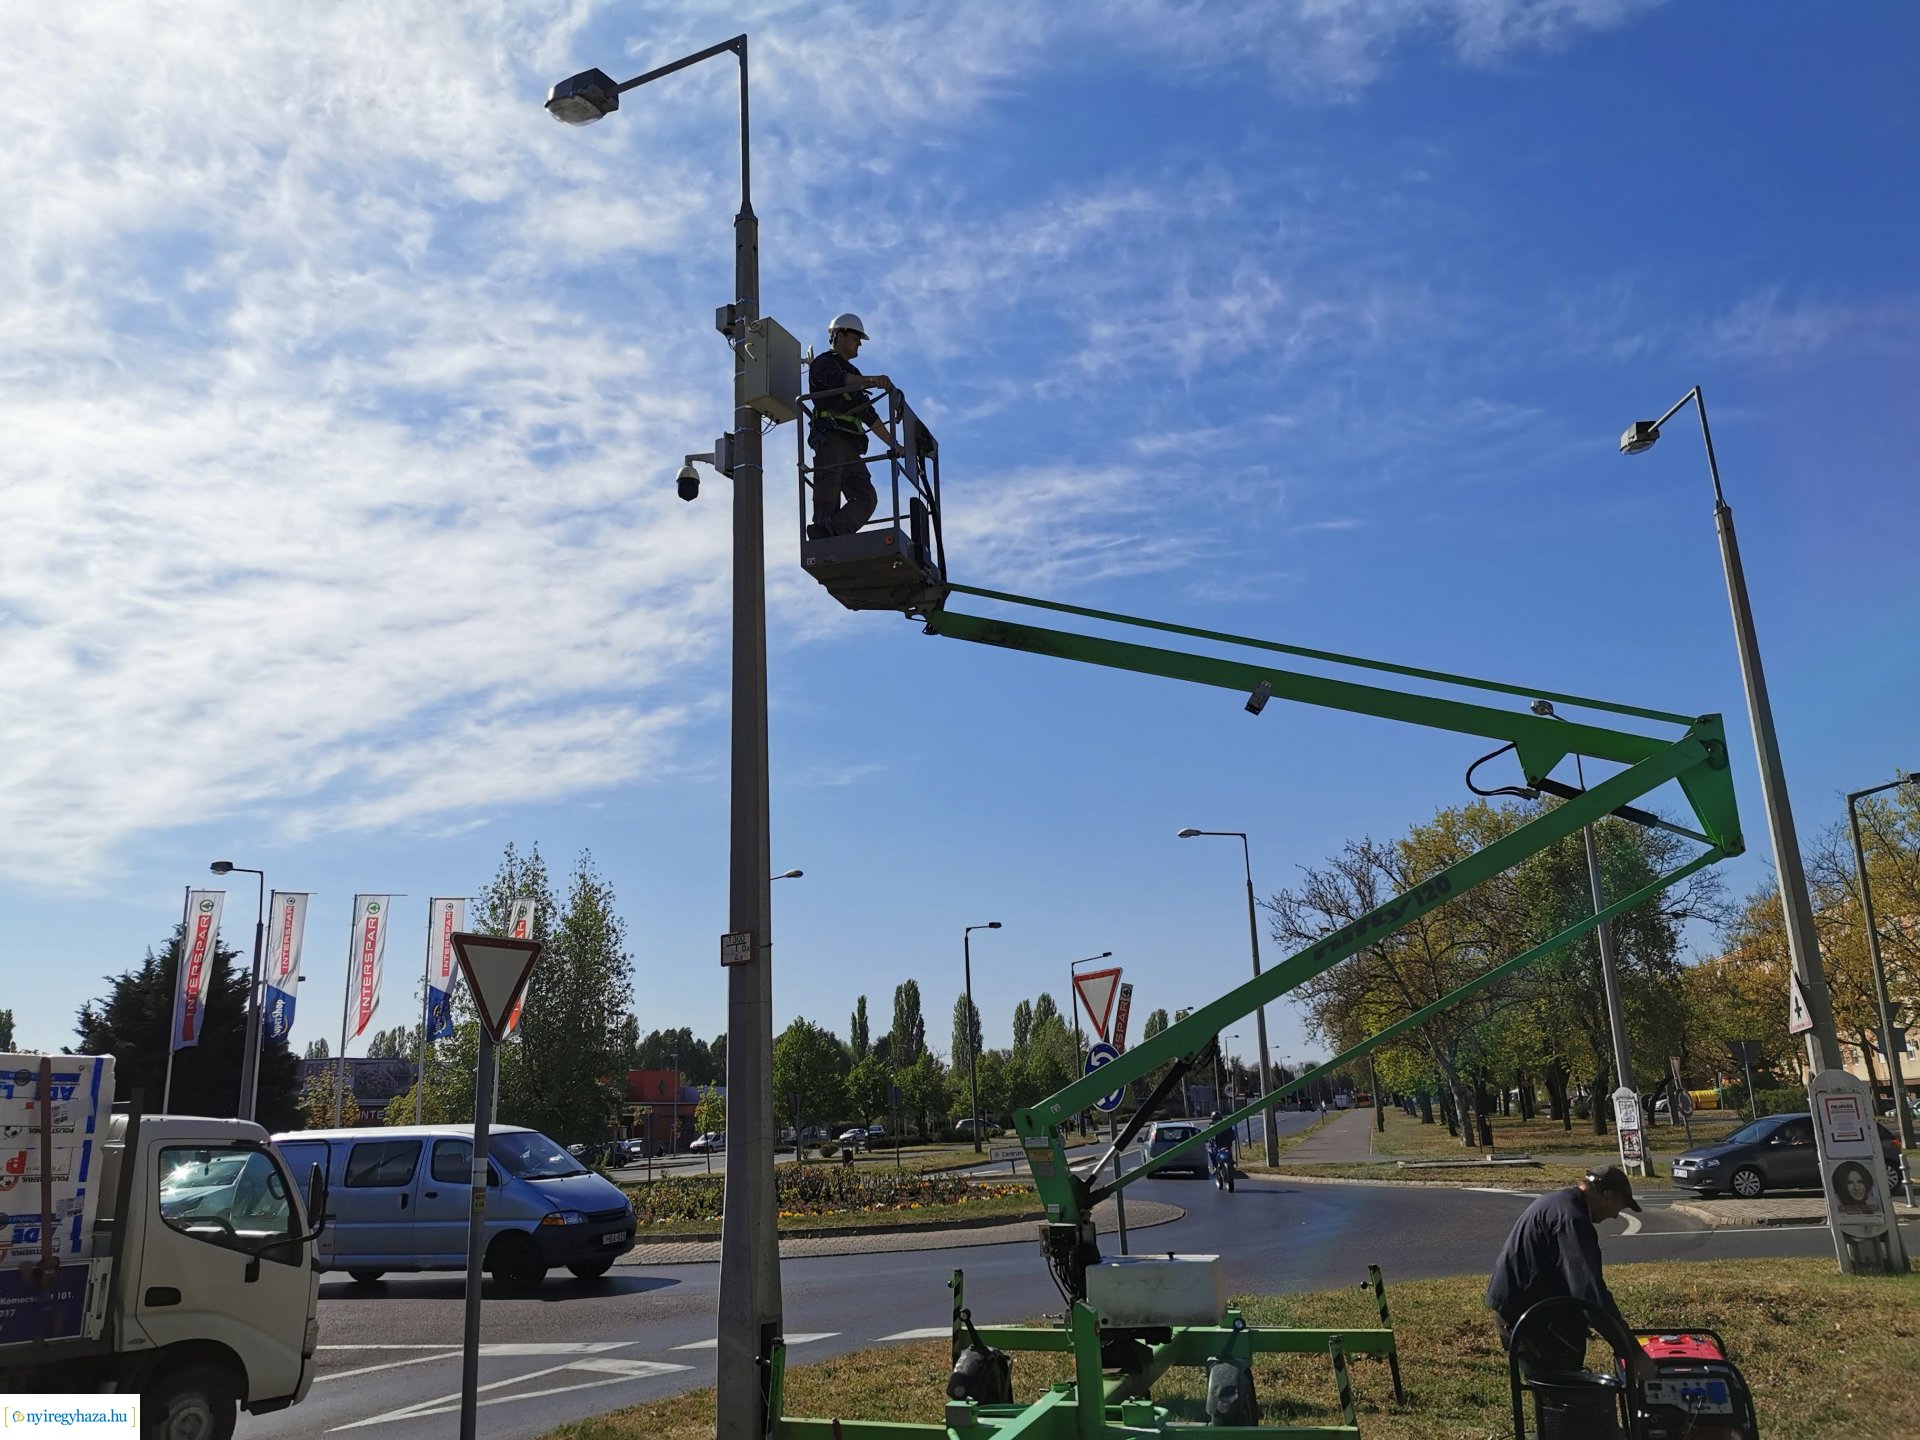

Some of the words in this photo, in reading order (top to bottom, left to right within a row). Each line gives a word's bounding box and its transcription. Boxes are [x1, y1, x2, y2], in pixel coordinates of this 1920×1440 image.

[1413, 875, 1452, 906] 120
[186, 916, 210, 1016] INTERSPAR
[282, 906, 294, 969] INTERSPAR
[361, 918, 377, 1014] INTERSPAR
[443, 911, 453, 972] INTERSPAR
[1001, 1150, 1024, 1158] Centrum
